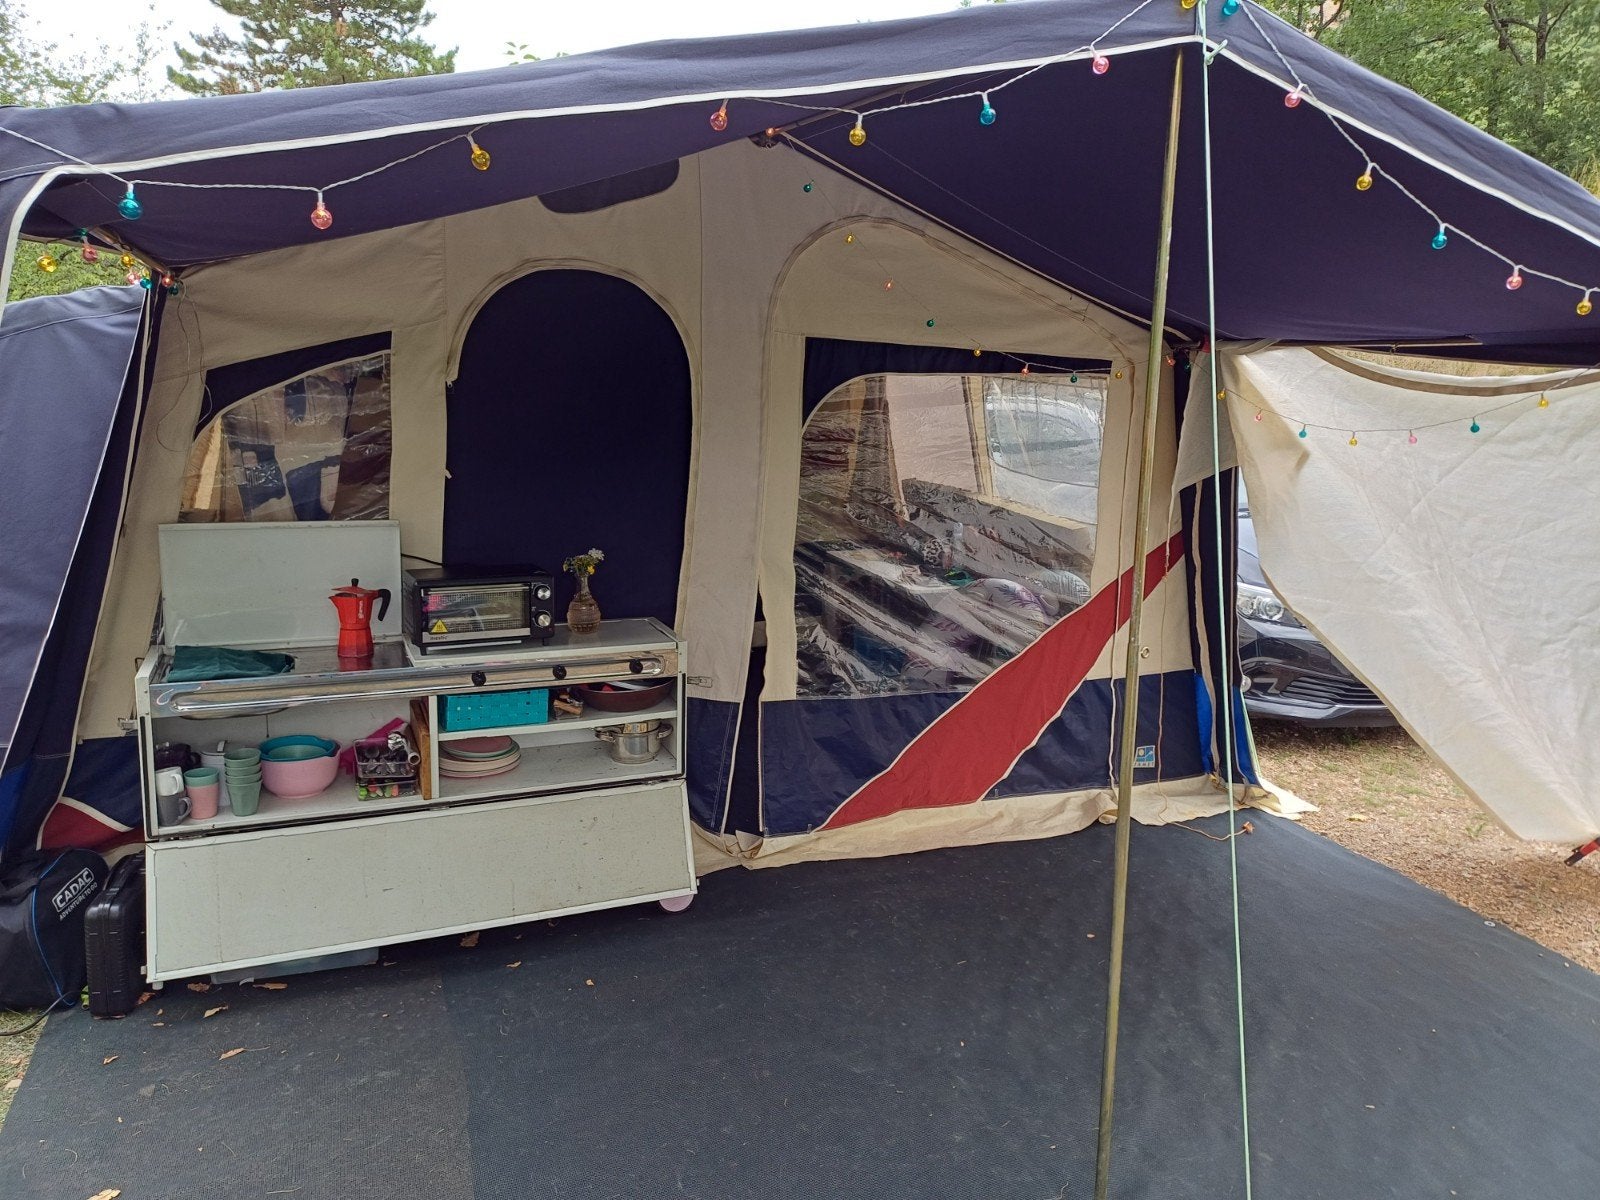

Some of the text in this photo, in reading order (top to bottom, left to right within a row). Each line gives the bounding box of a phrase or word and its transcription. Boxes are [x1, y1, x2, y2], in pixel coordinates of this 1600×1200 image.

[56, 870, 92, 908] CADAC
[59, 882, 97, 921] ADVENTURE TO GO
